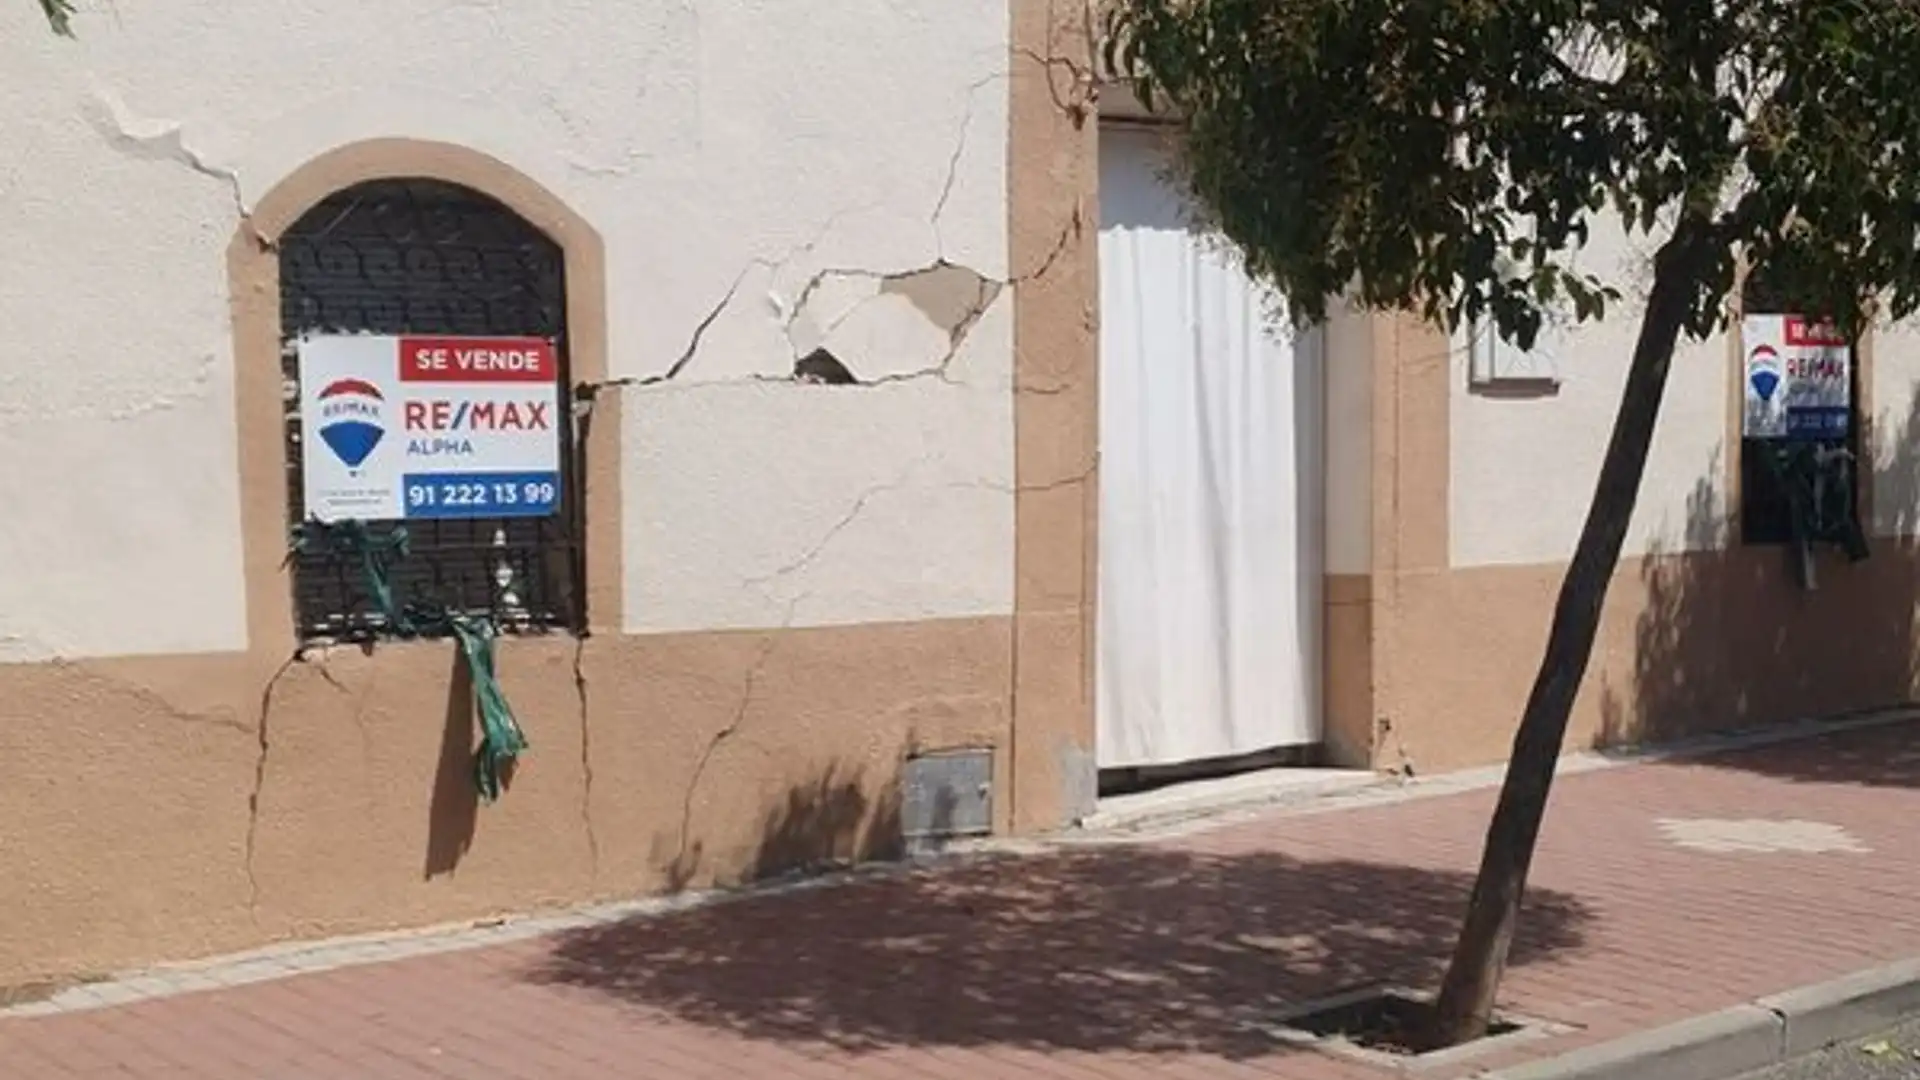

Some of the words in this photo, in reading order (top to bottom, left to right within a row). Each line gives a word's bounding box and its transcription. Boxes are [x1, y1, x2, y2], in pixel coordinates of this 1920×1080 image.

[416, 349, 448, 370] SE
[454, 350, 540, 370] VENDE
[404, 400, 549, 431] RE/MAX
[406, 439, 473, 455] ALPHA
[409, 486, 434, 506] 91
[442, 485, 487, 505] 222
[492, 484, 517, 504] 13
[523, 483, 555, 504] 99
